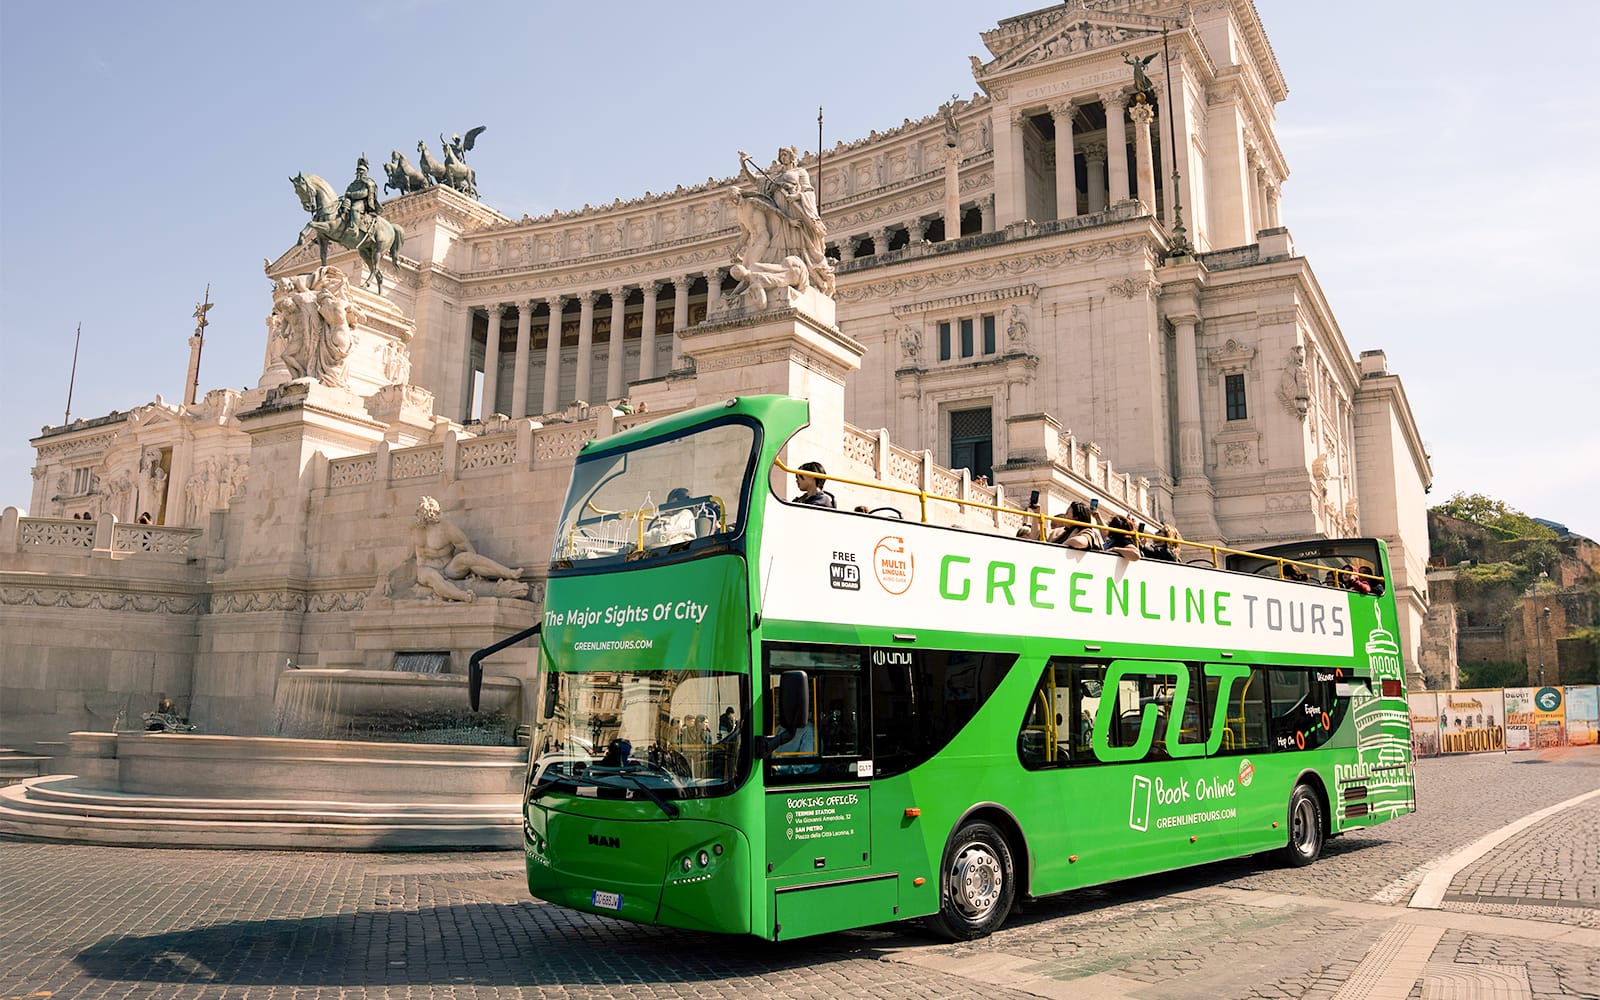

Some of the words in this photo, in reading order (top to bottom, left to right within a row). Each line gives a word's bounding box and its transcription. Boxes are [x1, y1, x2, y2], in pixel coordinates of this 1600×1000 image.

[832, 551, 856, 562] FREE
[881, 559, 906, 570] MULTI
[881, 568, 906, 577] LINGUAL
[938, 554, 1232, 626] GREENLINE
[1243, 594, 1344, 636] TOURS
[544, 611, 564, 628] The
[566, 607, 602, 629] Major
[604, 605, 649, 628] Sights
[652, 602, 672, 621] Of
[674, 600, 709, 623] City
[574, 639, 653, 651] GREENLINETOURS.COM
[1277, 736, 1287, 749] Hop
[1287, 735, 1295, 746] On
[1155, 776, 1191, 805] Book
[1195, 775, 1237, 801] Online
[787, 797, 824, 809] BOOKING
[826, 794, 859, 806] OFFICES
[1156, 808, 1237, 829] GREENLINETOURS.COM
[588, 834, 620, 848] MAN
